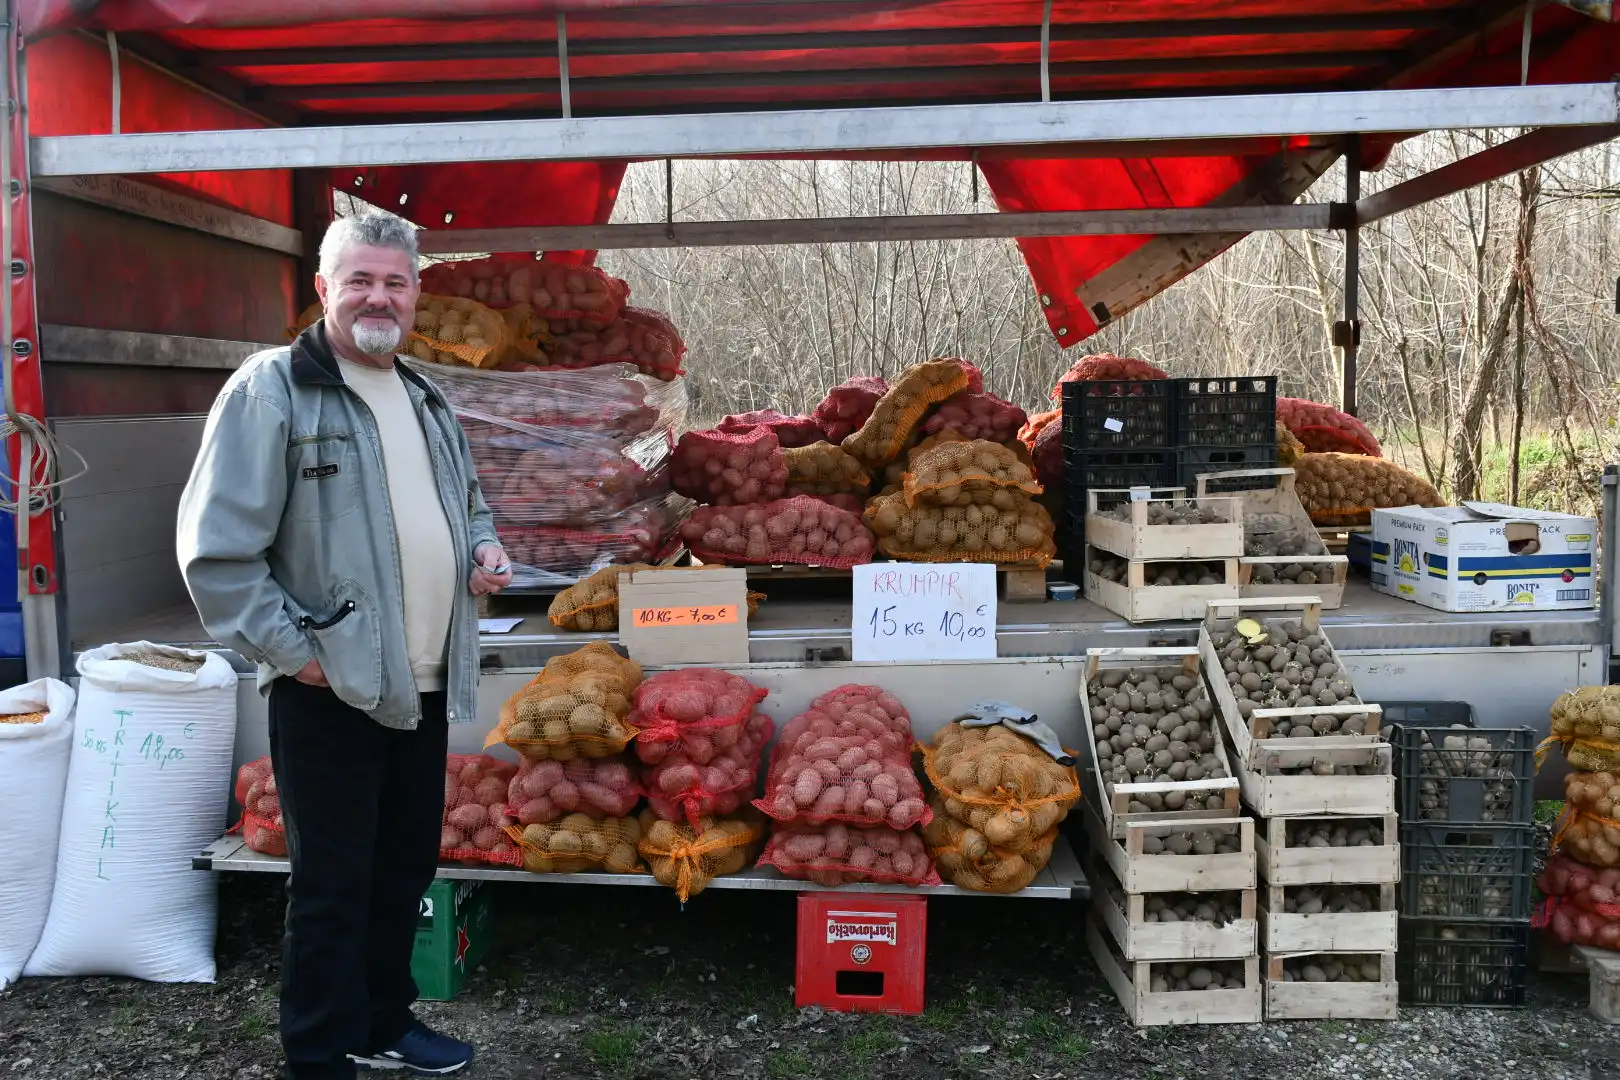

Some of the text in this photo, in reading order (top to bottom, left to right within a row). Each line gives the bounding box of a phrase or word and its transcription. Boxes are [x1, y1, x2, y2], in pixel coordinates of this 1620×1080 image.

[1391, 518, 1426, 532] PREMIUM PACK
[1394, 538, 1421, 571] BONITA
[873, 570, 963, 600] KRUMPIR
[640, 609, 654, 623] 10
[656, 610, 671, 622] KG
[690, 608, 716, 623] 7,00
[869, 604, 988, 642] 15 KG 10,00 €
[183, 722, 198, 740] €
[96, 710, 135, 881] TRITIKAL
[828, 923, 895, 940] Karlovačko
